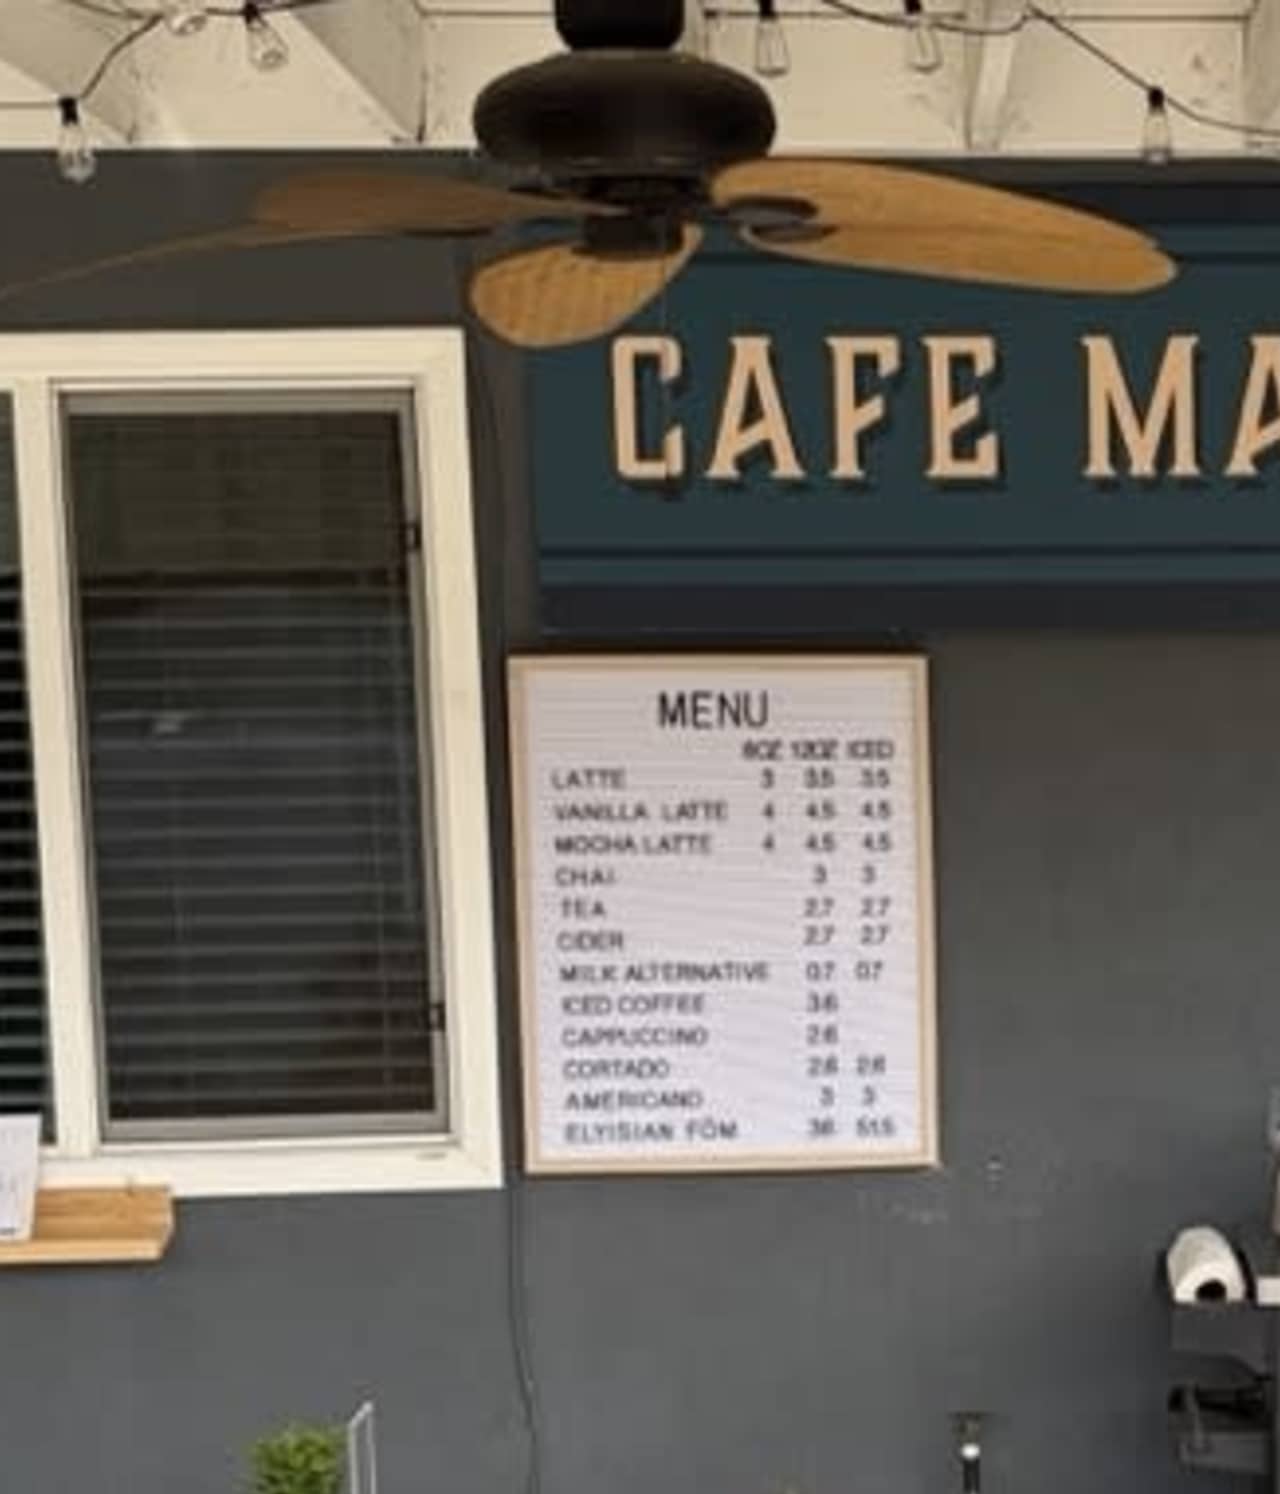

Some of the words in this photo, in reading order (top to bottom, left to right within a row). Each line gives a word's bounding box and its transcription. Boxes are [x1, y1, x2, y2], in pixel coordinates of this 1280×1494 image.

[608, 330, 1004, 484] CAFE
[659, 692, 769, 728] MENU
[846, 739, 895, 760] ICED
[551, 769, 626, 790] LATTE
[760, 767, 774, 789] 3
[554, 803, 650, 820] VANILLA
[662, 800, 729, 821] LATTE
[555, 836, 637, 855] MOCHA
[642, 834, 713, 855] LATTE
[555, 866, 617, 887] CHAI
[813, 864, 828, 884] 3
[862, 864, 876, 884] 3
[561, 897, 607, 918] TEA
[556, 930, 623, 951] CIDER
[560, 964, 617, 982] MILK
[624, 960, 770, 982] ALTERNATIVE
[562, 996, 612, 1016] ICED
[618, 993, 705, 1014] COFFEE
[561, 1026, 709, 1048] CAPPUCCINO
[563, 1057, 670, 1079] CORTADO
[565, 1090, 705, 1111] AMERICANO
[821, 1085, 834, 1107] 3
[862, 1085, 876, 1106] 3
[565, 1121, 674, 1144] ELYISIAN
